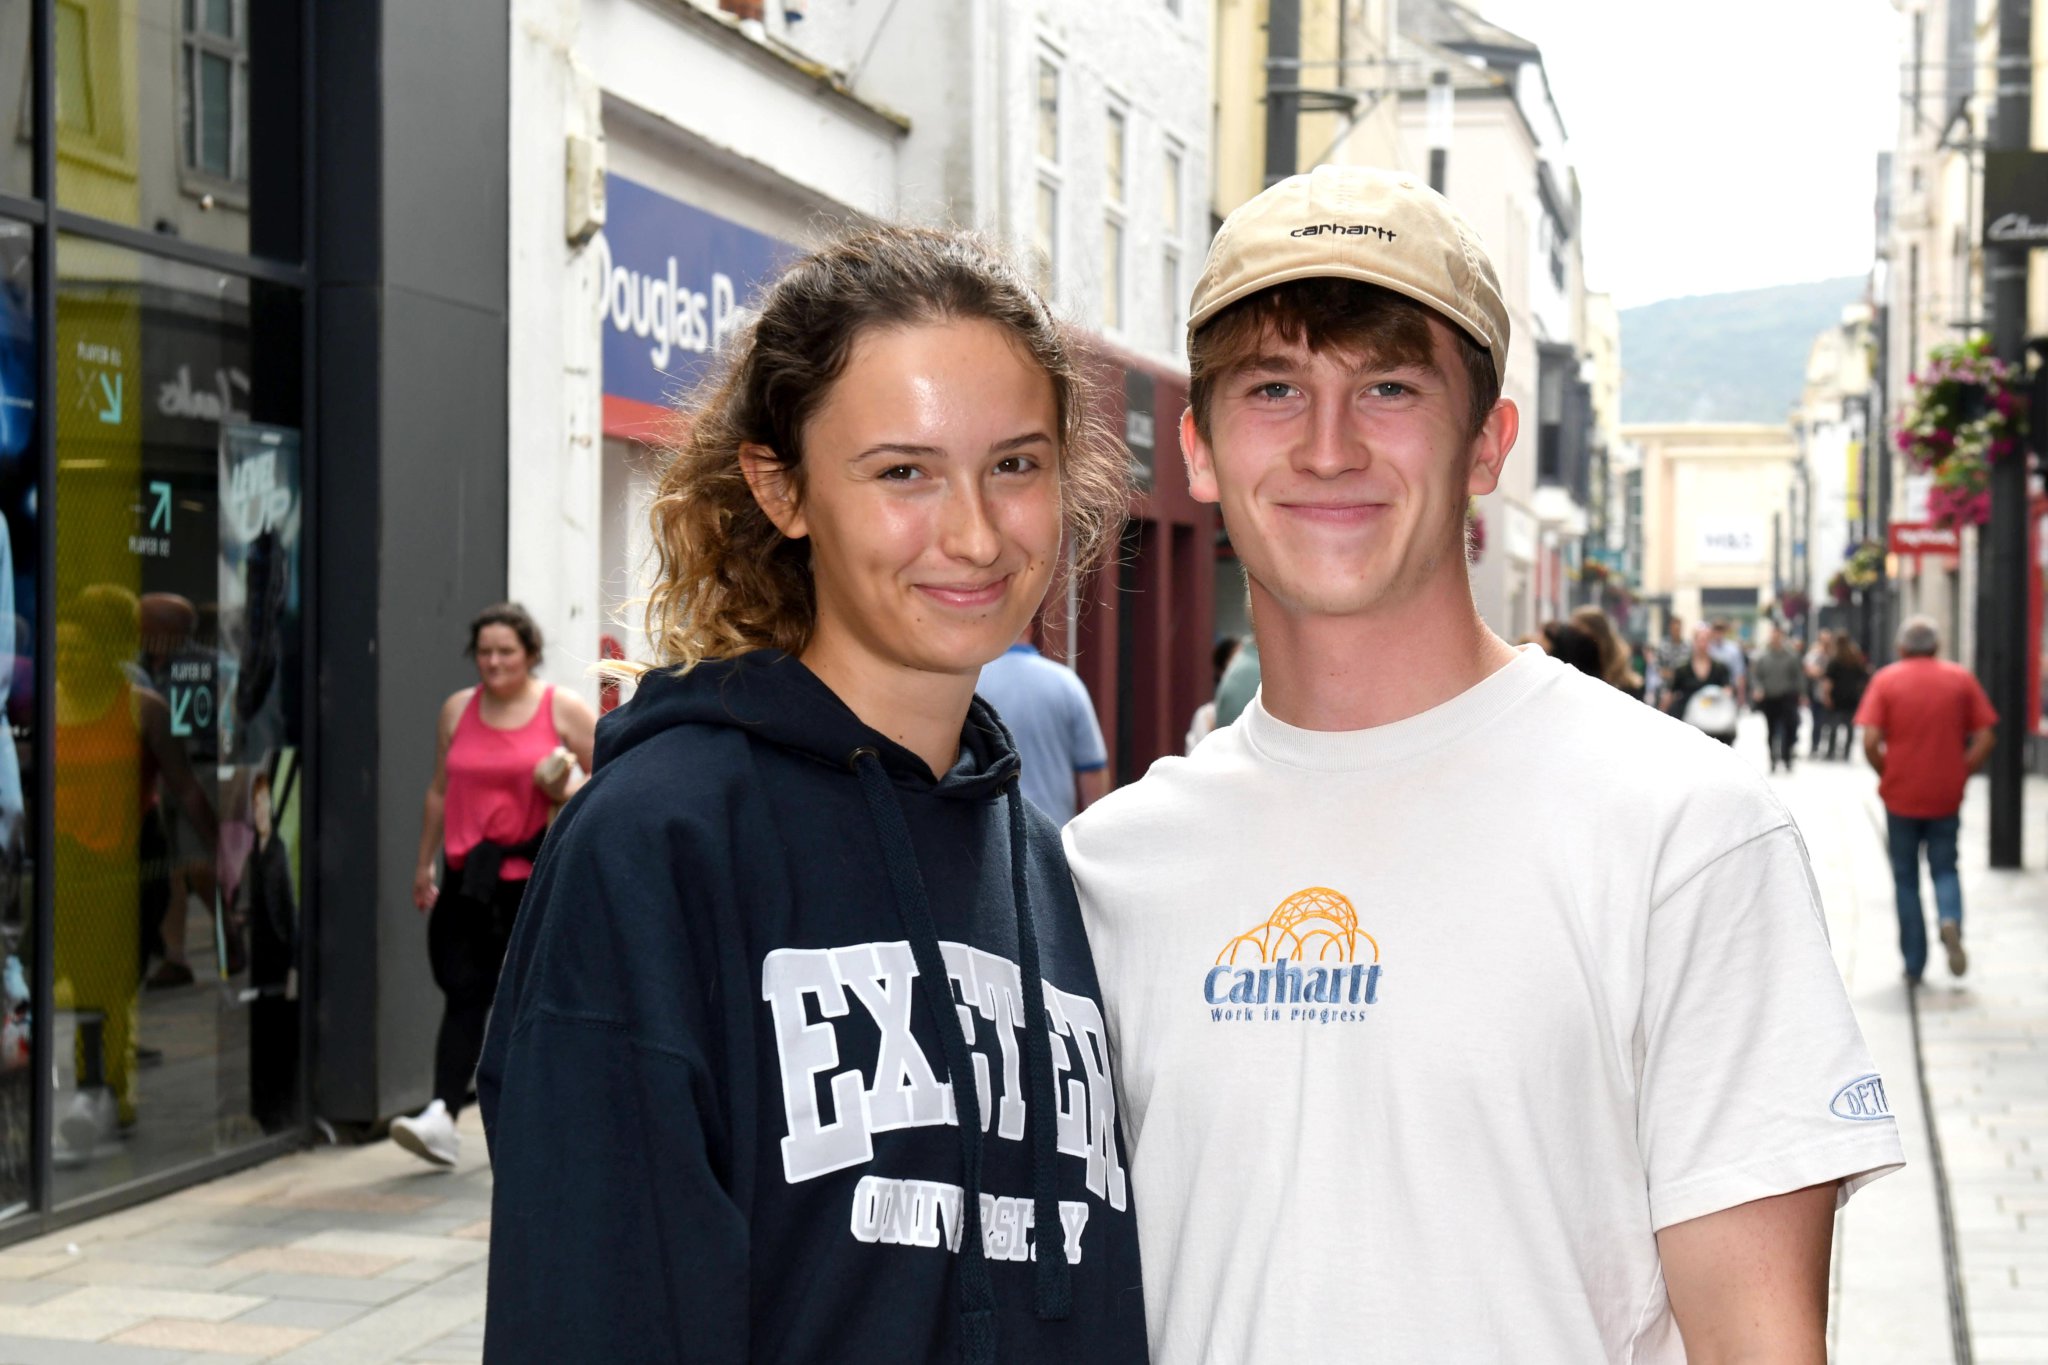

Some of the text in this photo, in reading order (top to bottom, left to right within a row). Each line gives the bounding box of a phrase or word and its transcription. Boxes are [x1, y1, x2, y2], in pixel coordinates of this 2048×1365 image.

[1290, 223, 1397, 242] carhartt
[1203, 957, 1384, 1005] Carhartt
[1211, 1006, 1366, 1025] Work in Progress
[850, 1175, 1089, 1265] UNIVRSIY
